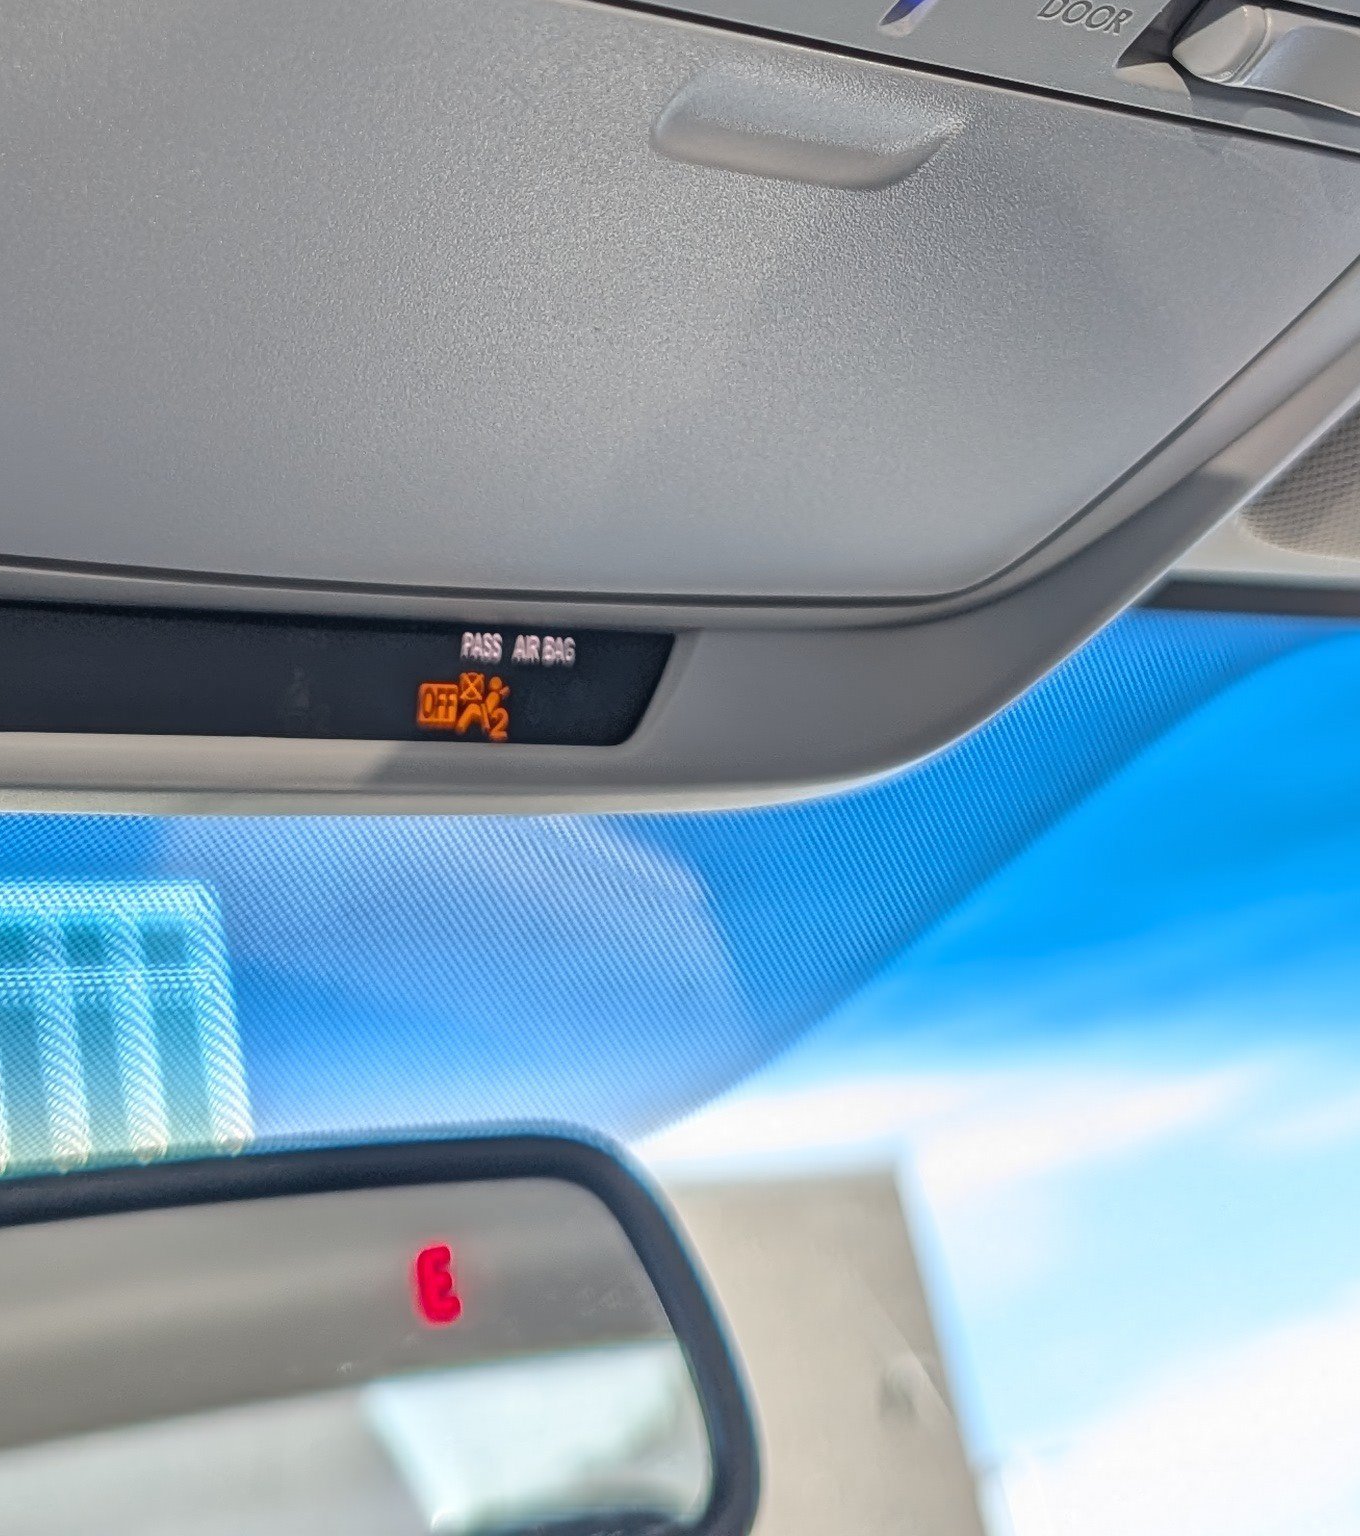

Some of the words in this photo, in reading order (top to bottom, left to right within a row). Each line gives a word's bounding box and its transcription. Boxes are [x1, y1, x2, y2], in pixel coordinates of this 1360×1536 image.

[461, 632, 503, 663] PASS
[541, 635, 576, 666] BAG
[420, 685, 457, 721] OFF
[416, 1244, 462, 1324] E
